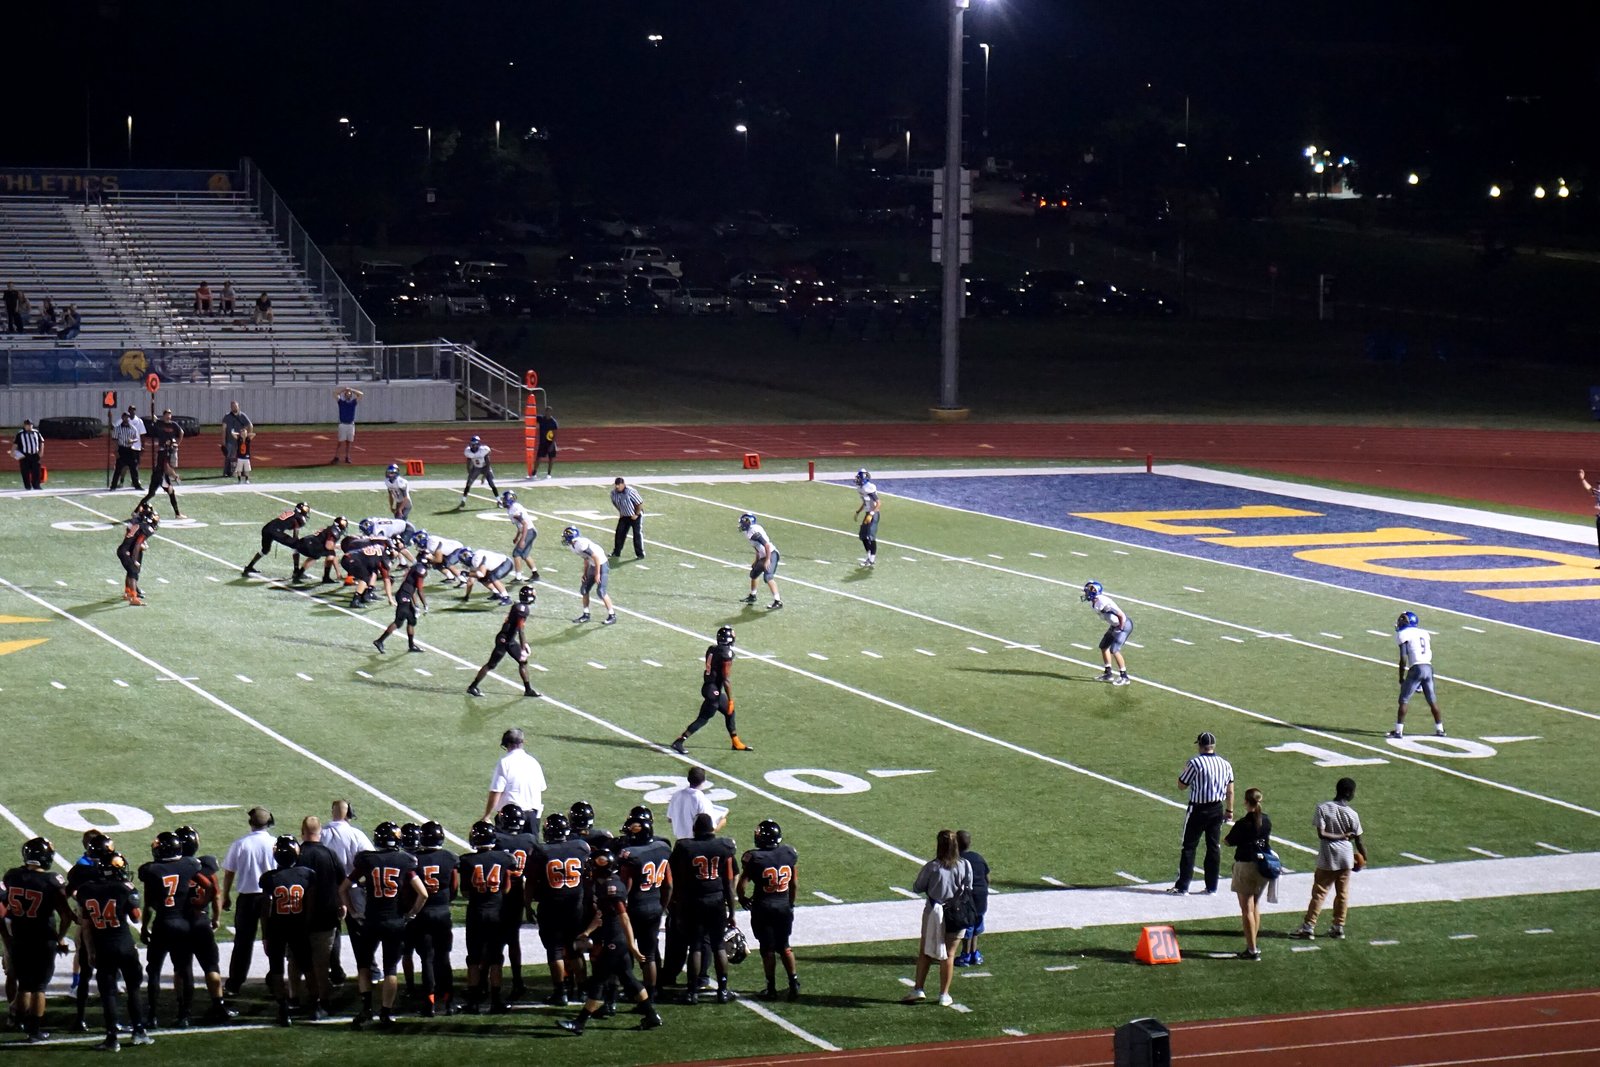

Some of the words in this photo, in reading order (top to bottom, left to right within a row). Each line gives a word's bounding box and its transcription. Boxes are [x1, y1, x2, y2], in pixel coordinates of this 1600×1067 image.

[410, 461, 422, 475] 10
[1419, 637, 1426, 655] 9
[371, 866, 400, 898] 15
[472, 863, 501, 894] 44
[546, 858, 581, 889] 66
[640, 859, 669, 891] 34
[692, 855, 720, 880] 31
[762, 865, 792, 893] 32
[8, 886, 43, 918] 57
[162, 875, 180, 907] 7
[274, 884, 304, 915] 20
[86, 899, 120, 929] 24
[1149, 930, 1178, 960] 20
